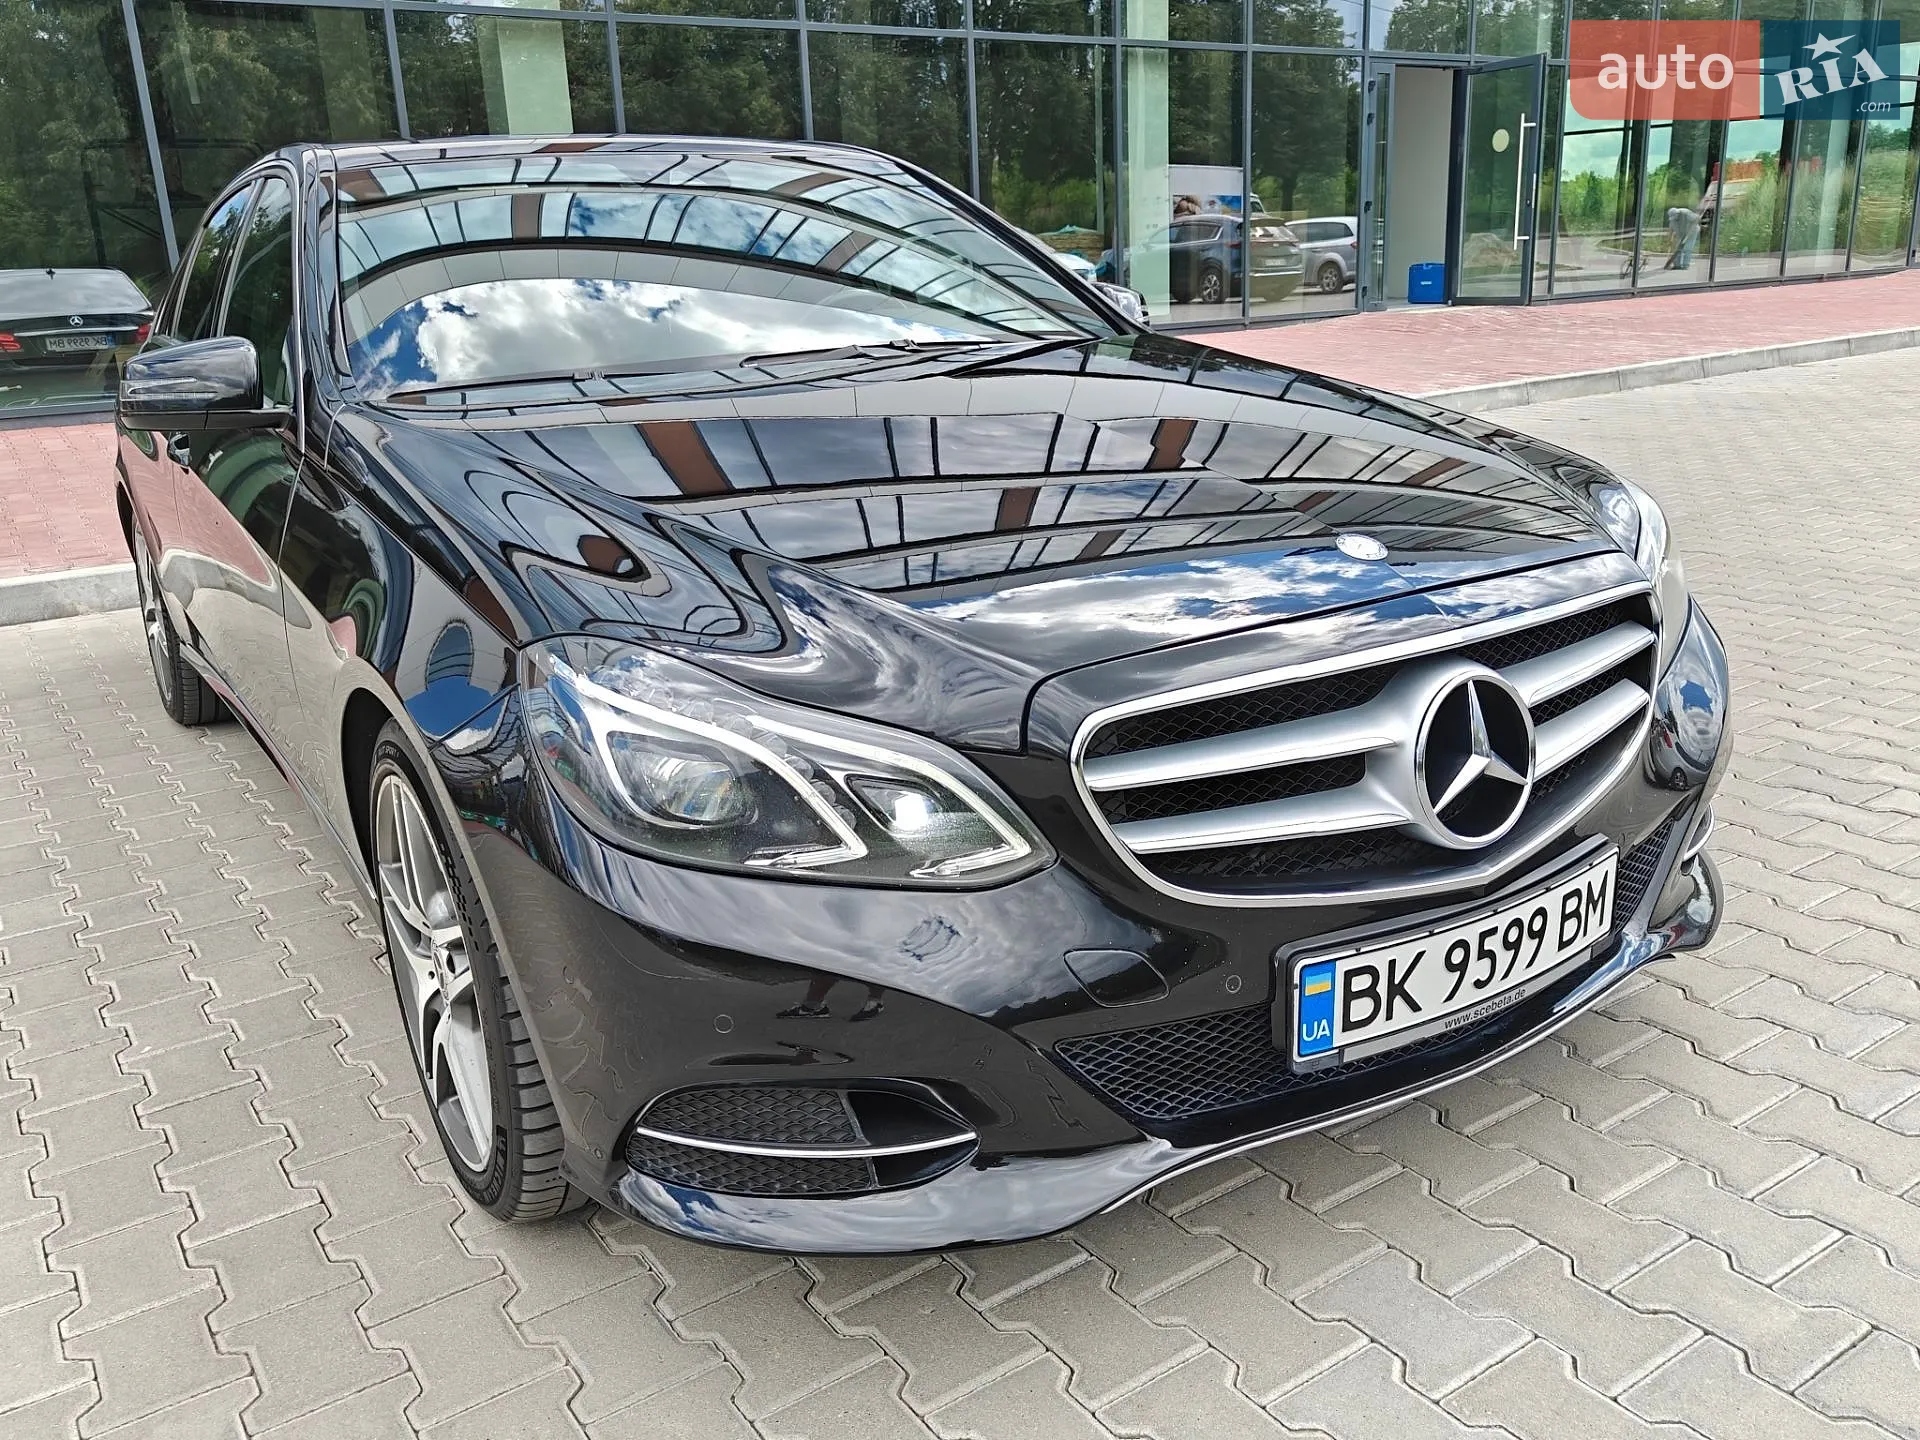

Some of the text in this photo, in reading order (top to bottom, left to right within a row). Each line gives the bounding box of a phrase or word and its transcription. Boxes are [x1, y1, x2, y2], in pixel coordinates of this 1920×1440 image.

[1342, 869, 1609, 1032] BK 9599 BM
[1302, 1019, 1331, 1041] UA
[1444, 988, 1526, 1030] www.scebeta.de
